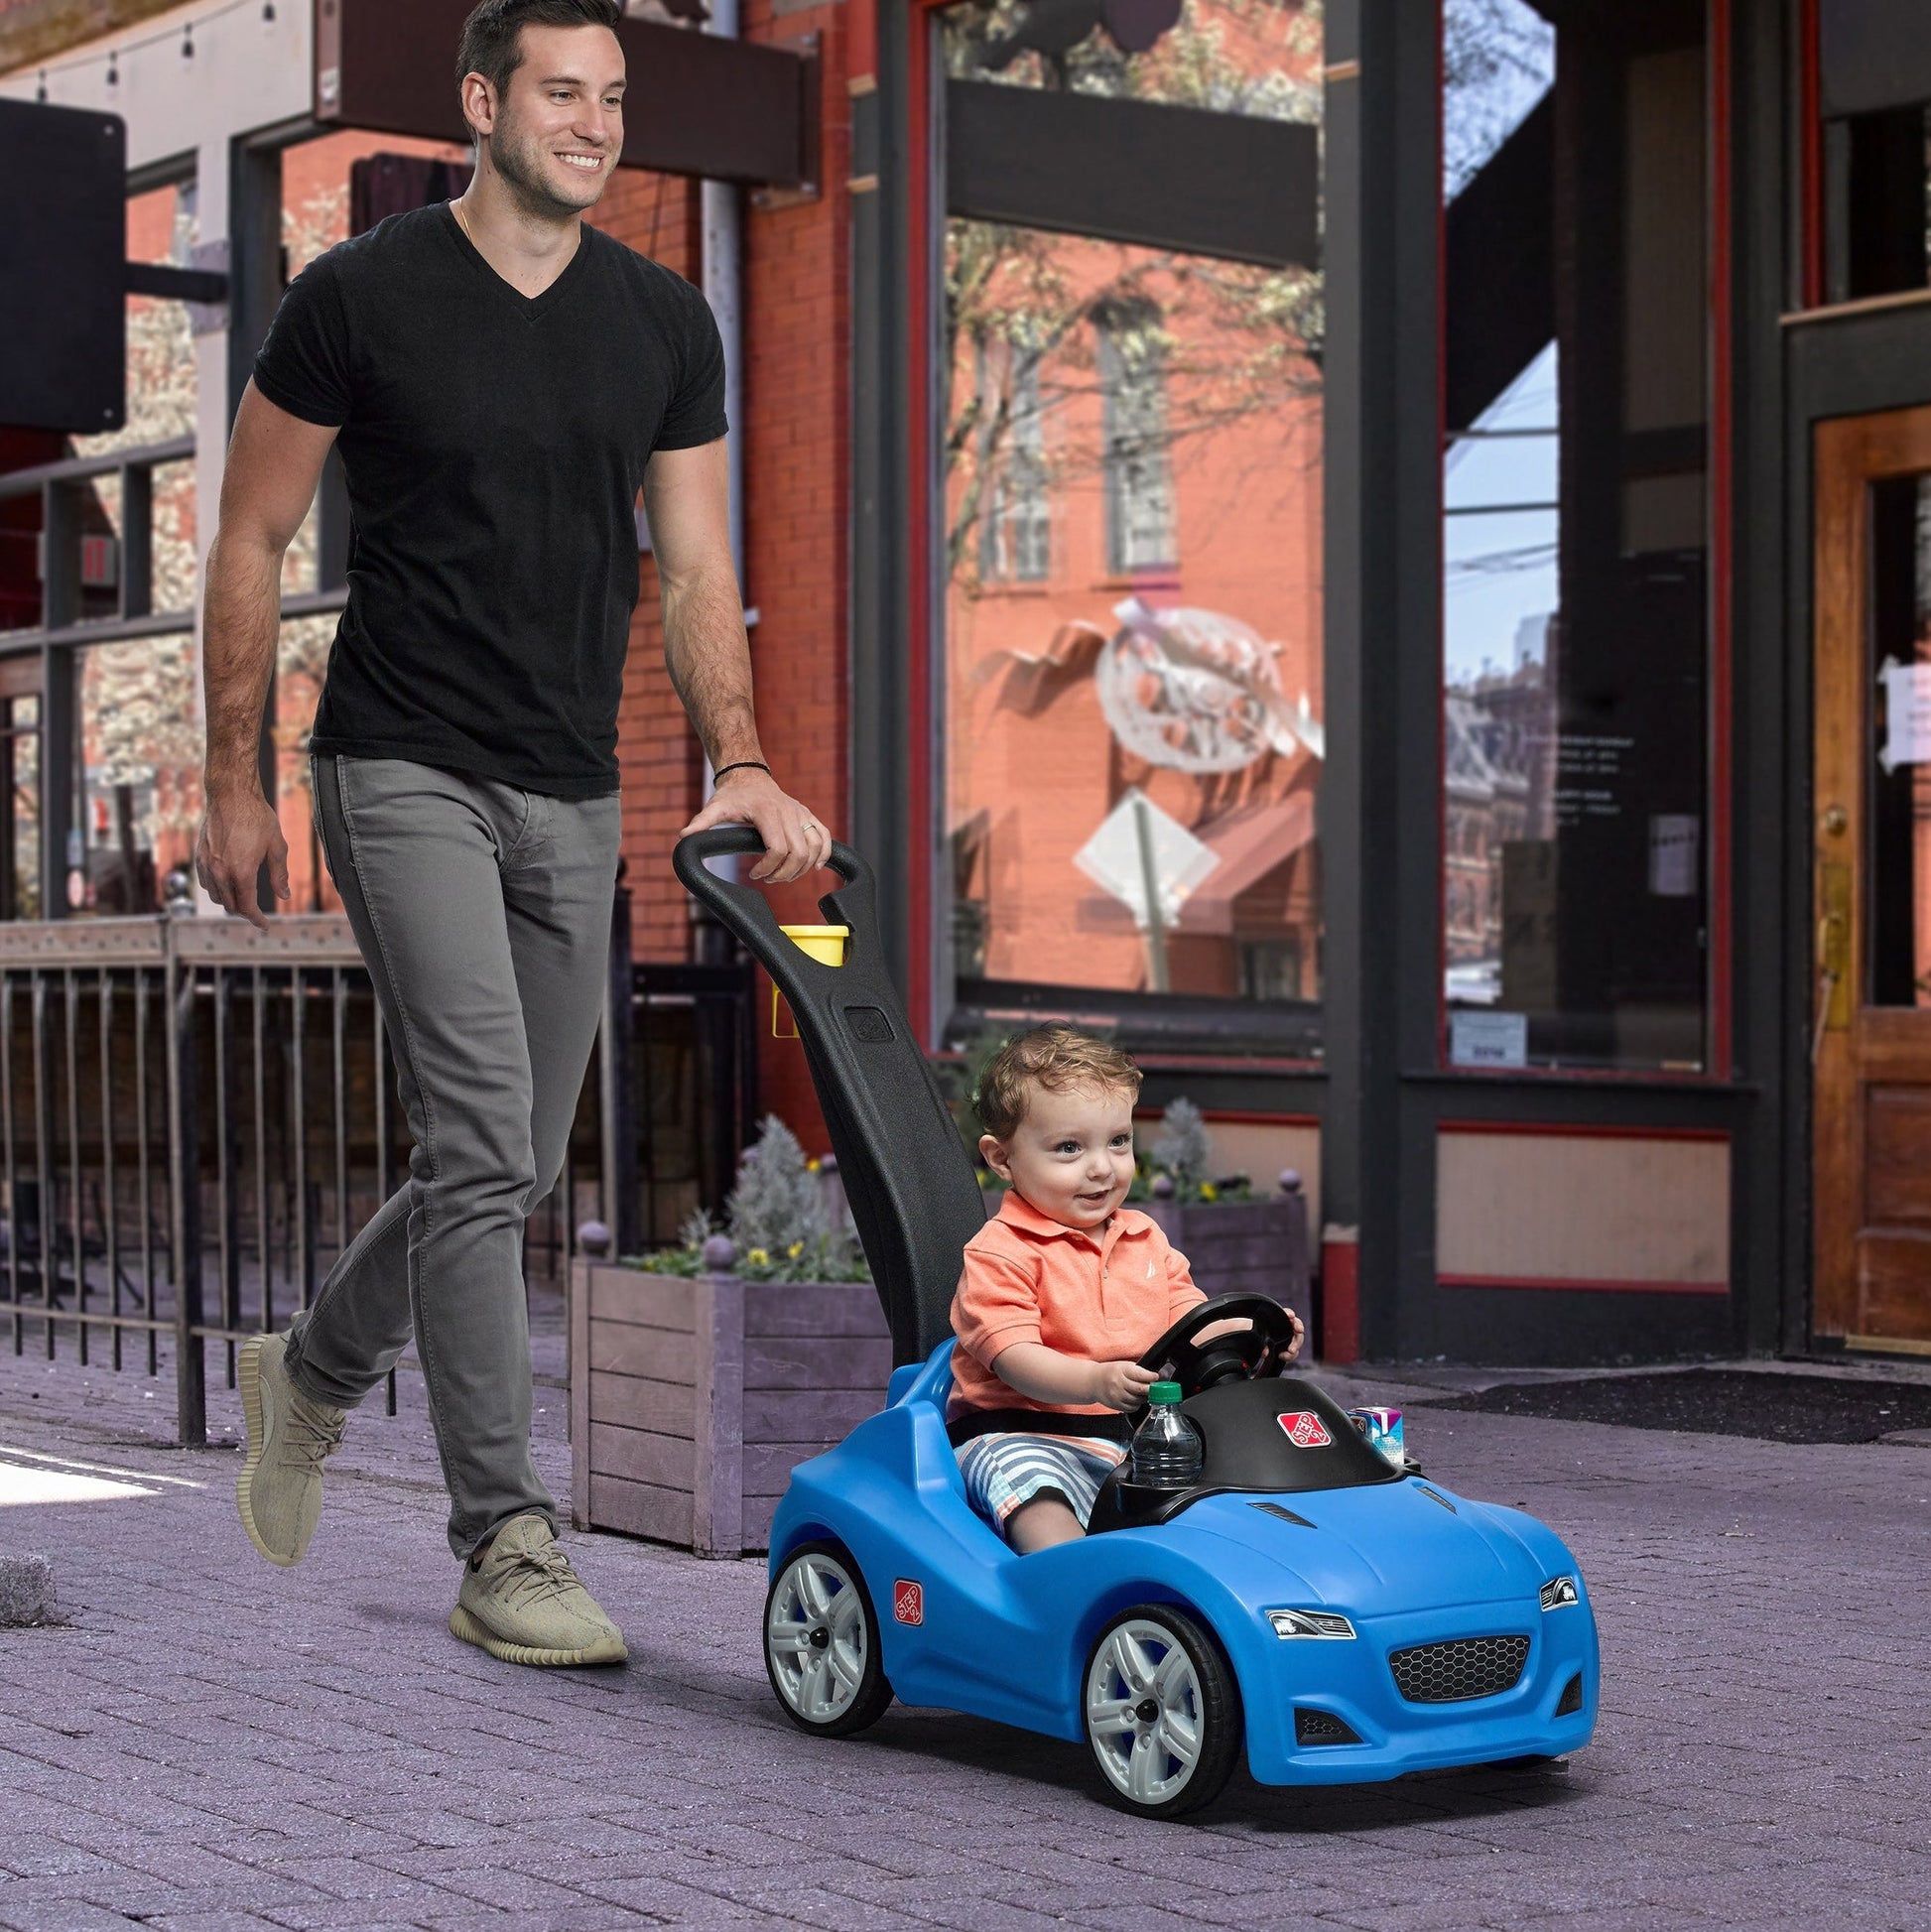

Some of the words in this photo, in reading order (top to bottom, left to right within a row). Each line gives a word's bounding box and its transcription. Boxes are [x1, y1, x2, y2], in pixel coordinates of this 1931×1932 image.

[1292, 1414, 1314, 1443] STEP
[1311, 1429, 1326, 1443] 2
[910, 1605, 921, 1622] 2
